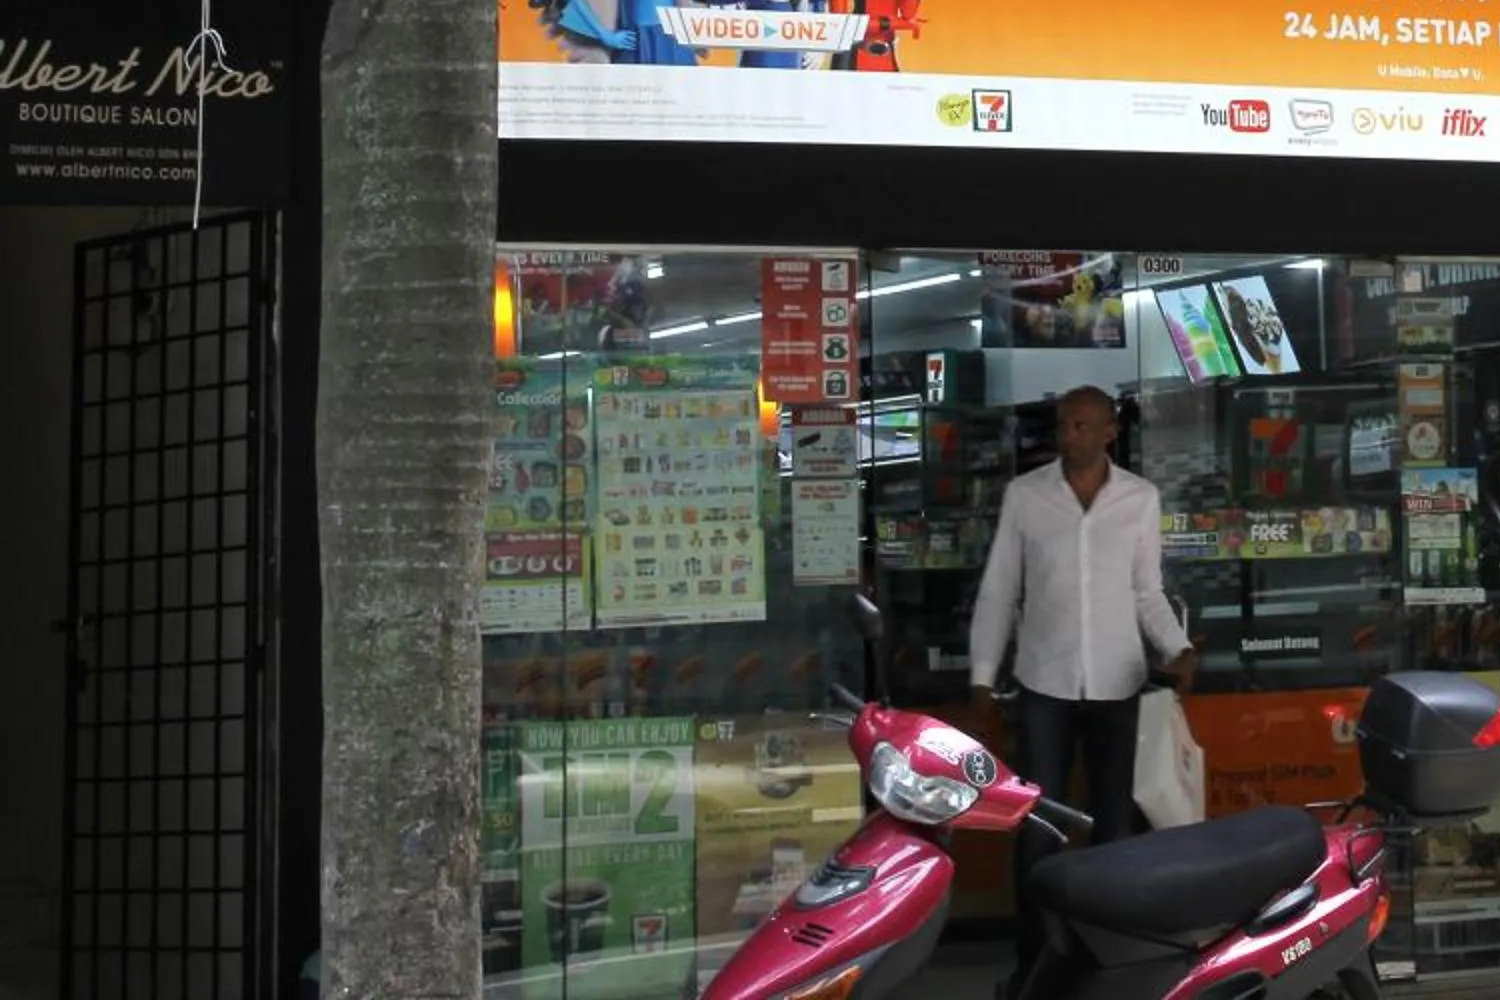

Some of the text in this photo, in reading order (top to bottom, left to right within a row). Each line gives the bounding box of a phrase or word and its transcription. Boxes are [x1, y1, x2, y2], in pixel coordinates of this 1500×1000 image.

[690, 17, 828, 41] VIDEO ONZ
[1284, 12, 1318, 39] 24
[1324, 14, 1390, 46] JAM,
[1396, 17, 1491, 48] SETIAP
[144, 45, 275, 97] Nico
[19, 102, 197, 127] BOUTIQUE SALON
[1201, 102, 1269, 129] YouTube
[1379, 107, 1425, 131] viu
[1441, 108, 1487, 137] iflix
[1144, 259, 1180, 273] 0300
[1250, 523, 1290, 542] FREE
[571, 726, 599, 746] YOU
[606, 725, 636, 745] CAN
[641, 722, 690, 743] ENJOY
